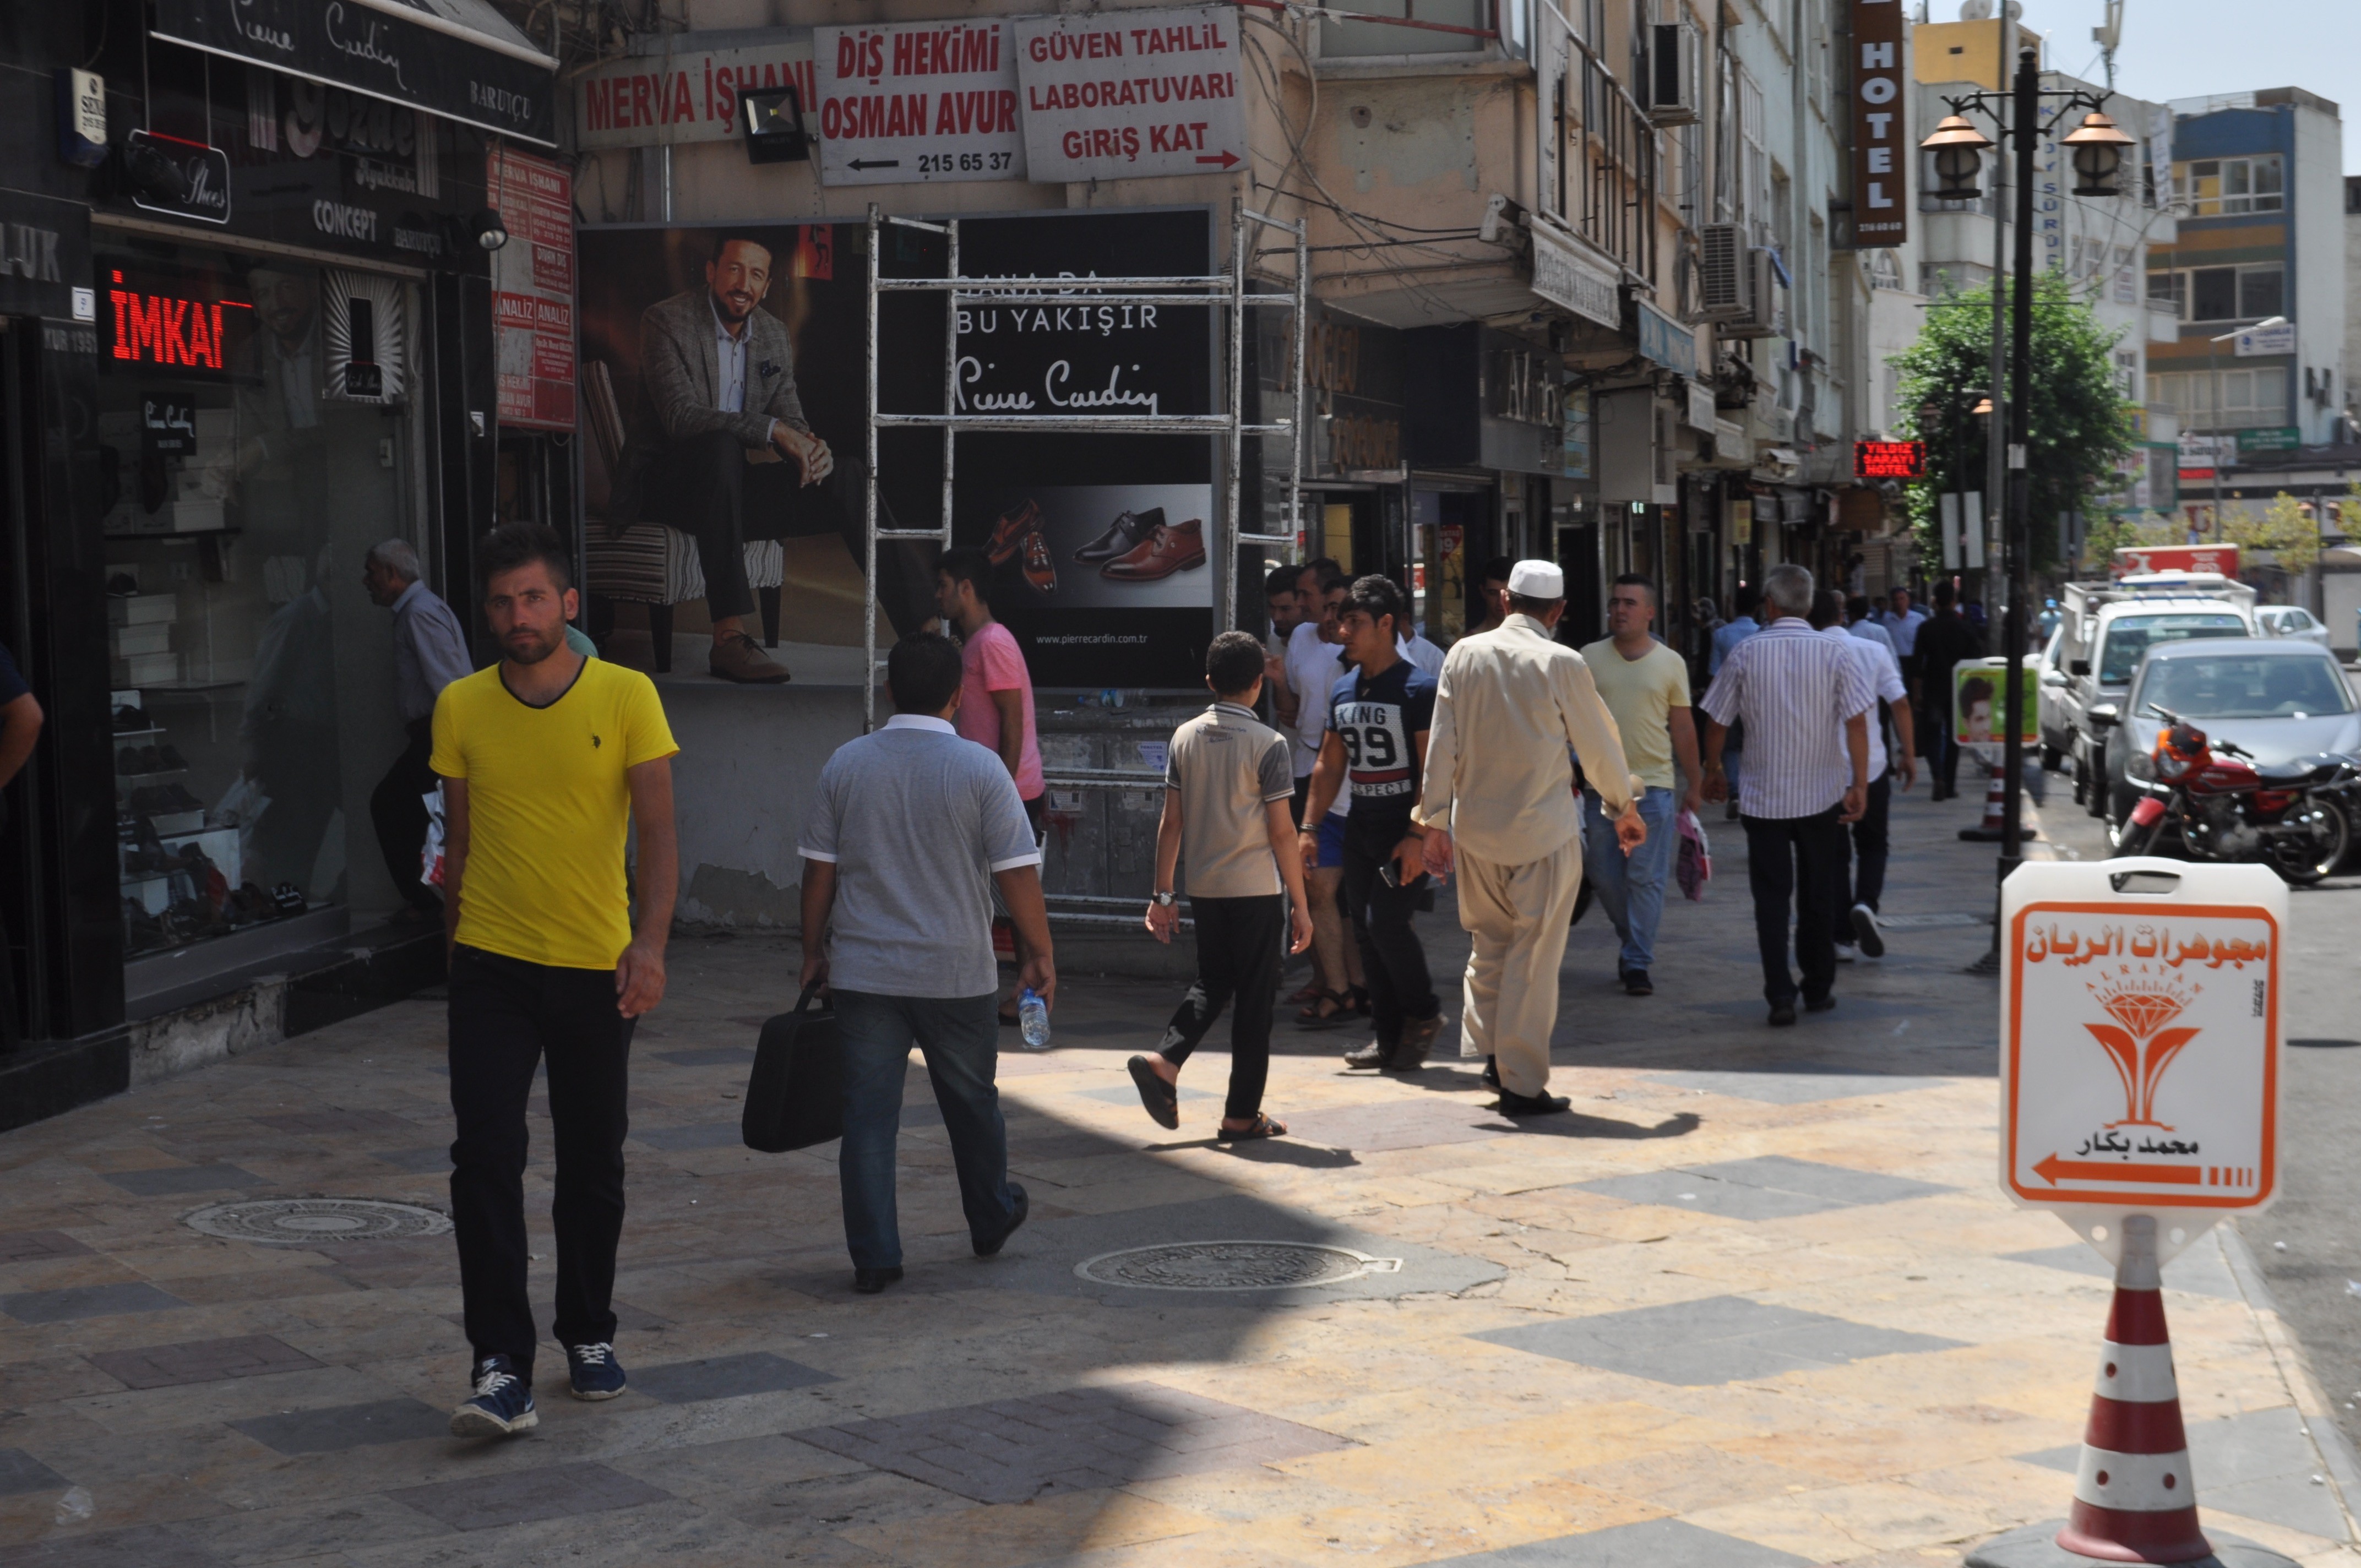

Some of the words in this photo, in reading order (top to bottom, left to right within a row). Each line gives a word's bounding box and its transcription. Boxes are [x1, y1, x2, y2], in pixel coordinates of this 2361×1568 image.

[325, 1, 408, 91] Cardin
[1029, 30, 1123, 63] GÜVEN
[470, 80, 531, 122] BARUTÇU
[586, 72, 695, 131] MERVA
[1029, 72, 1234, 111] LABORATUVARI
[822, 94, 927, 139] OSMAN
[935, 90, 1017, 135] AVUR
[1860, 41, 1897, 209] HOTEL
[1149, 122, 1208, 153] KAT
[493, 161, 527, 183] MERVA
[918, 154, 953, 172] 215
[960, 153, 982, 171] 65
[989, 153, 1012, 170] 37
[312, 199, 378, 243] CONCEPT
[495, 298, 533, 319] ANALİZ
[537, 303, 569, 325] ANALİZ
[957, 310, 997, 334] BU
[1010, 304, 1157, 336] YAKIŞIR
[498, 391, 515, 405] SMAN
[955, 356, 1035, 411] Pierre
[1046, 360, 1158, 416] Cardin
[1863, 453, 1916, 465] SARAYI
[1865, 443, 1913, 454] YILDIZ
[1865, 464, 1912, 475] HOTEL
[1036, 633, 1148, 646] www.pierrecardin.com.tr
[1339, 706, 1386, 725] KING
[1340, 726, 1396, 767] 99
[1351, 781, 1405, 796] ESPECT
[2025, 922, 2124, 967] الريان
[2130, 923, 2267, 971] مجوهرات
[2075, 1131, 2130, 1160] بكار
[2137, 1135, 2199, 1155] محمد
